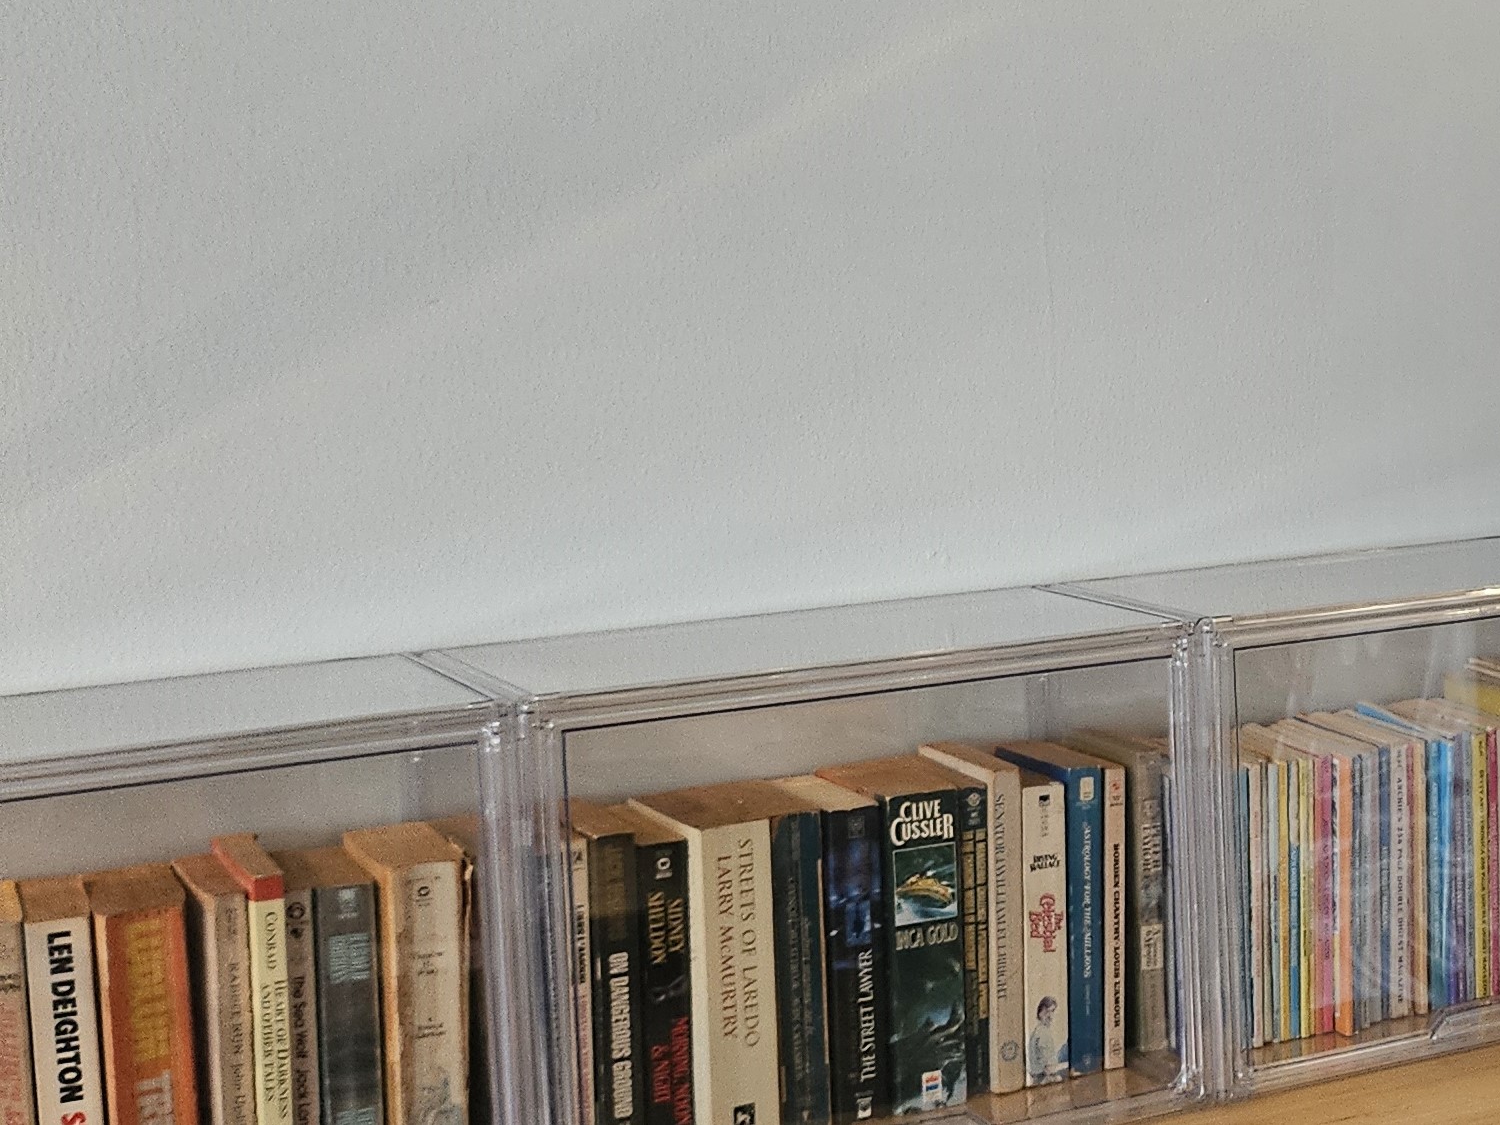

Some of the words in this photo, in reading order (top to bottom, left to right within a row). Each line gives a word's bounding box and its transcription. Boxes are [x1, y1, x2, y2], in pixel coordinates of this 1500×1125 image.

[890, 814, 954, 846] CUSSLER
[900, 800, 942, 823] CLIVE
[994, 794, 1006, 855] SENATOR
[1082, 824, 1093, 881] ASTROLOGY
[1113, 843, 1122, 888] BORDEN
[716, 854, 735, 917] LARRY
[738, 838, 756, 923] STREETS
[647, 891, 667, 964] SHELDON
[667, 898, 685, 953] SIDNEY
[896, 927, 925, 951] INCA
[927, 922, 959, 946] GOLD
[1113, 890, 1122, 942] CHANTRY
[47, 930, 74, 975] LEN
[265, 912, 279, 971] CONRAD
[608, 952, 629, 974] ON
[741, 929, 757, 958] OF
[292, 976, 307, 999] The
[719, 925, 739, 1039] McMURTRY
[857, 948, 874, 1004] LAWYER
[1397, 955, 1405, 1005] MAGAZINE
[274, 979, 288, 1025] HEART
[293, 1001, 309, 1028] Sea
[609, 976, 632, 1059] DANGEROUS
[742, 966, 761, 1048] LAREDO
[51, 979, 85, 1104] DEIGHTON
[262, 1012, 275, 1061] OTHER
[277, 1027, 289, 1046] OF
[859, 1006, 875, 1054] STREET
[263, 1063, 277, 1103] TALES
[277, 1048, 290, 1120] DARKNESS
[612, 1060, 634, 1119] GROUND
[653, 1060, 671, 1103] NIGHT
[860, 1055, 876, 1082] THE
